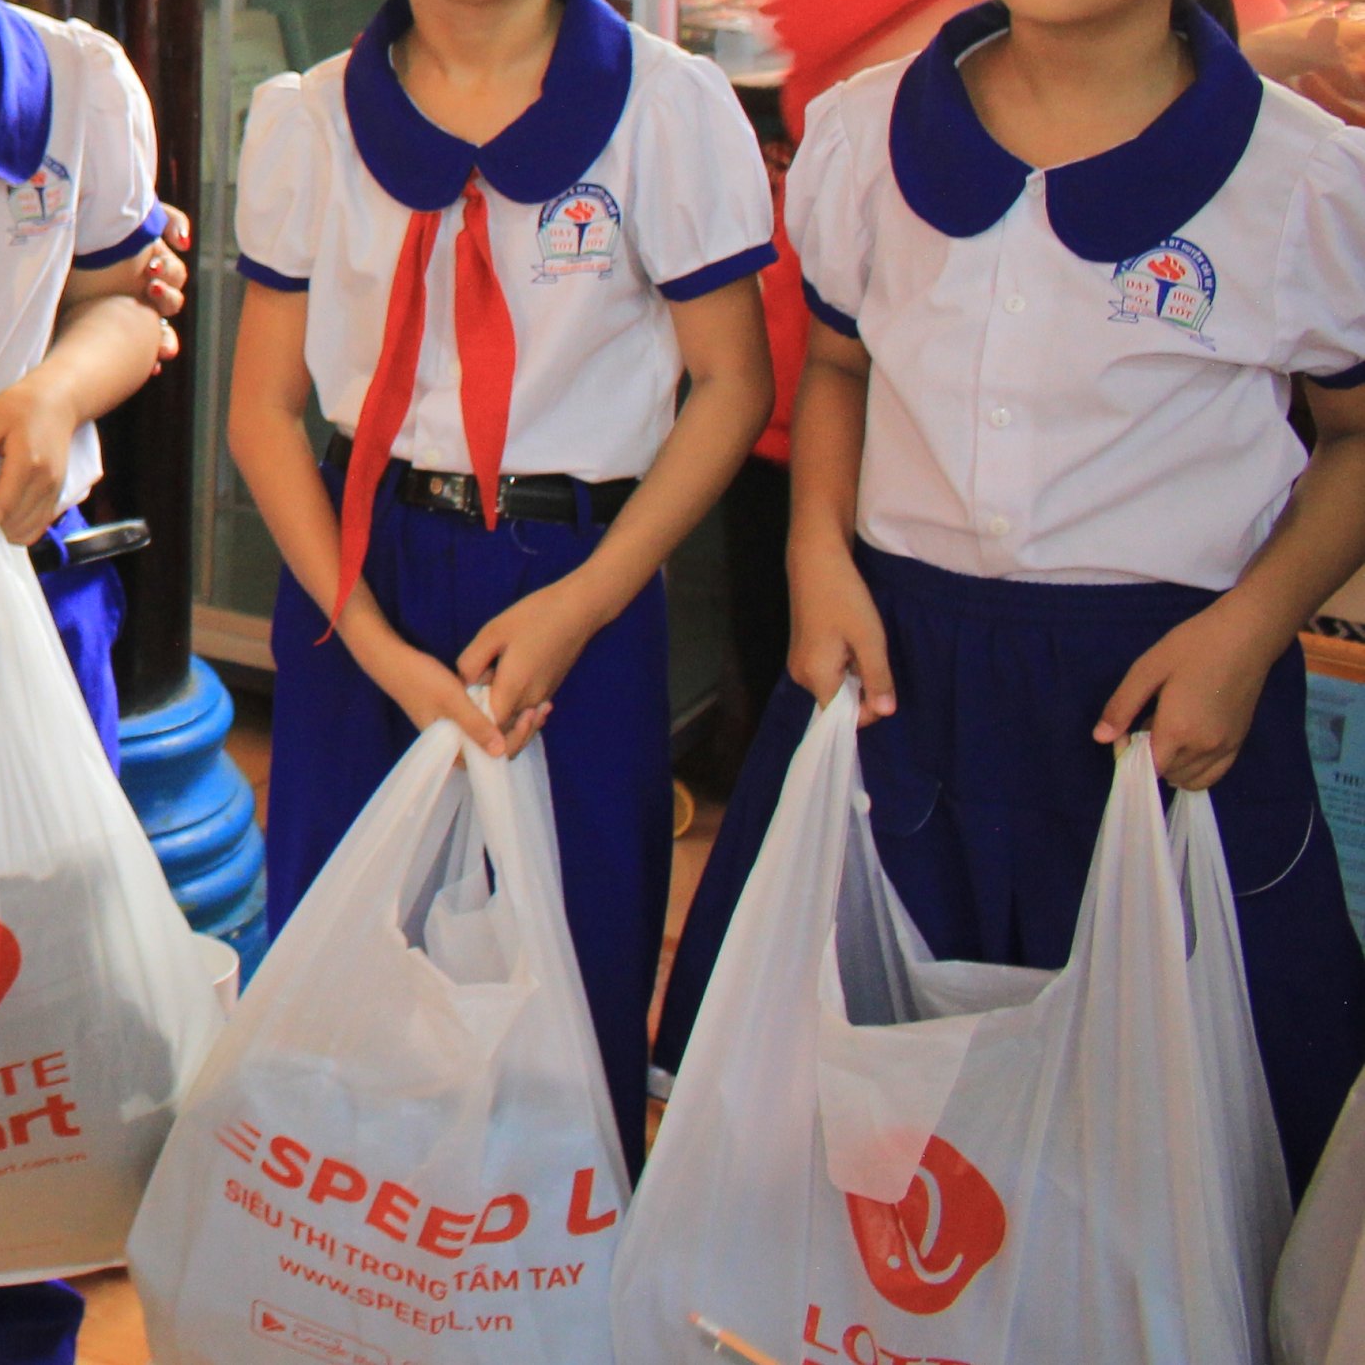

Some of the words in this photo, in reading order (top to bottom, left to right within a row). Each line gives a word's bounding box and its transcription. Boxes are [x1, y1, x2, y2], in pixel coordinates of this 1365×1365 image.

[223, 1179, 282, 1229] SIÊU
[289, 1217, 335, 1261] THỊ
[344, 1247, 449, 1301] TRONG
[528, 1262, 585, 1292] TAY
[261, 1135, 530, 1260] SPEED
[566, 1168, 618, 1237] L
